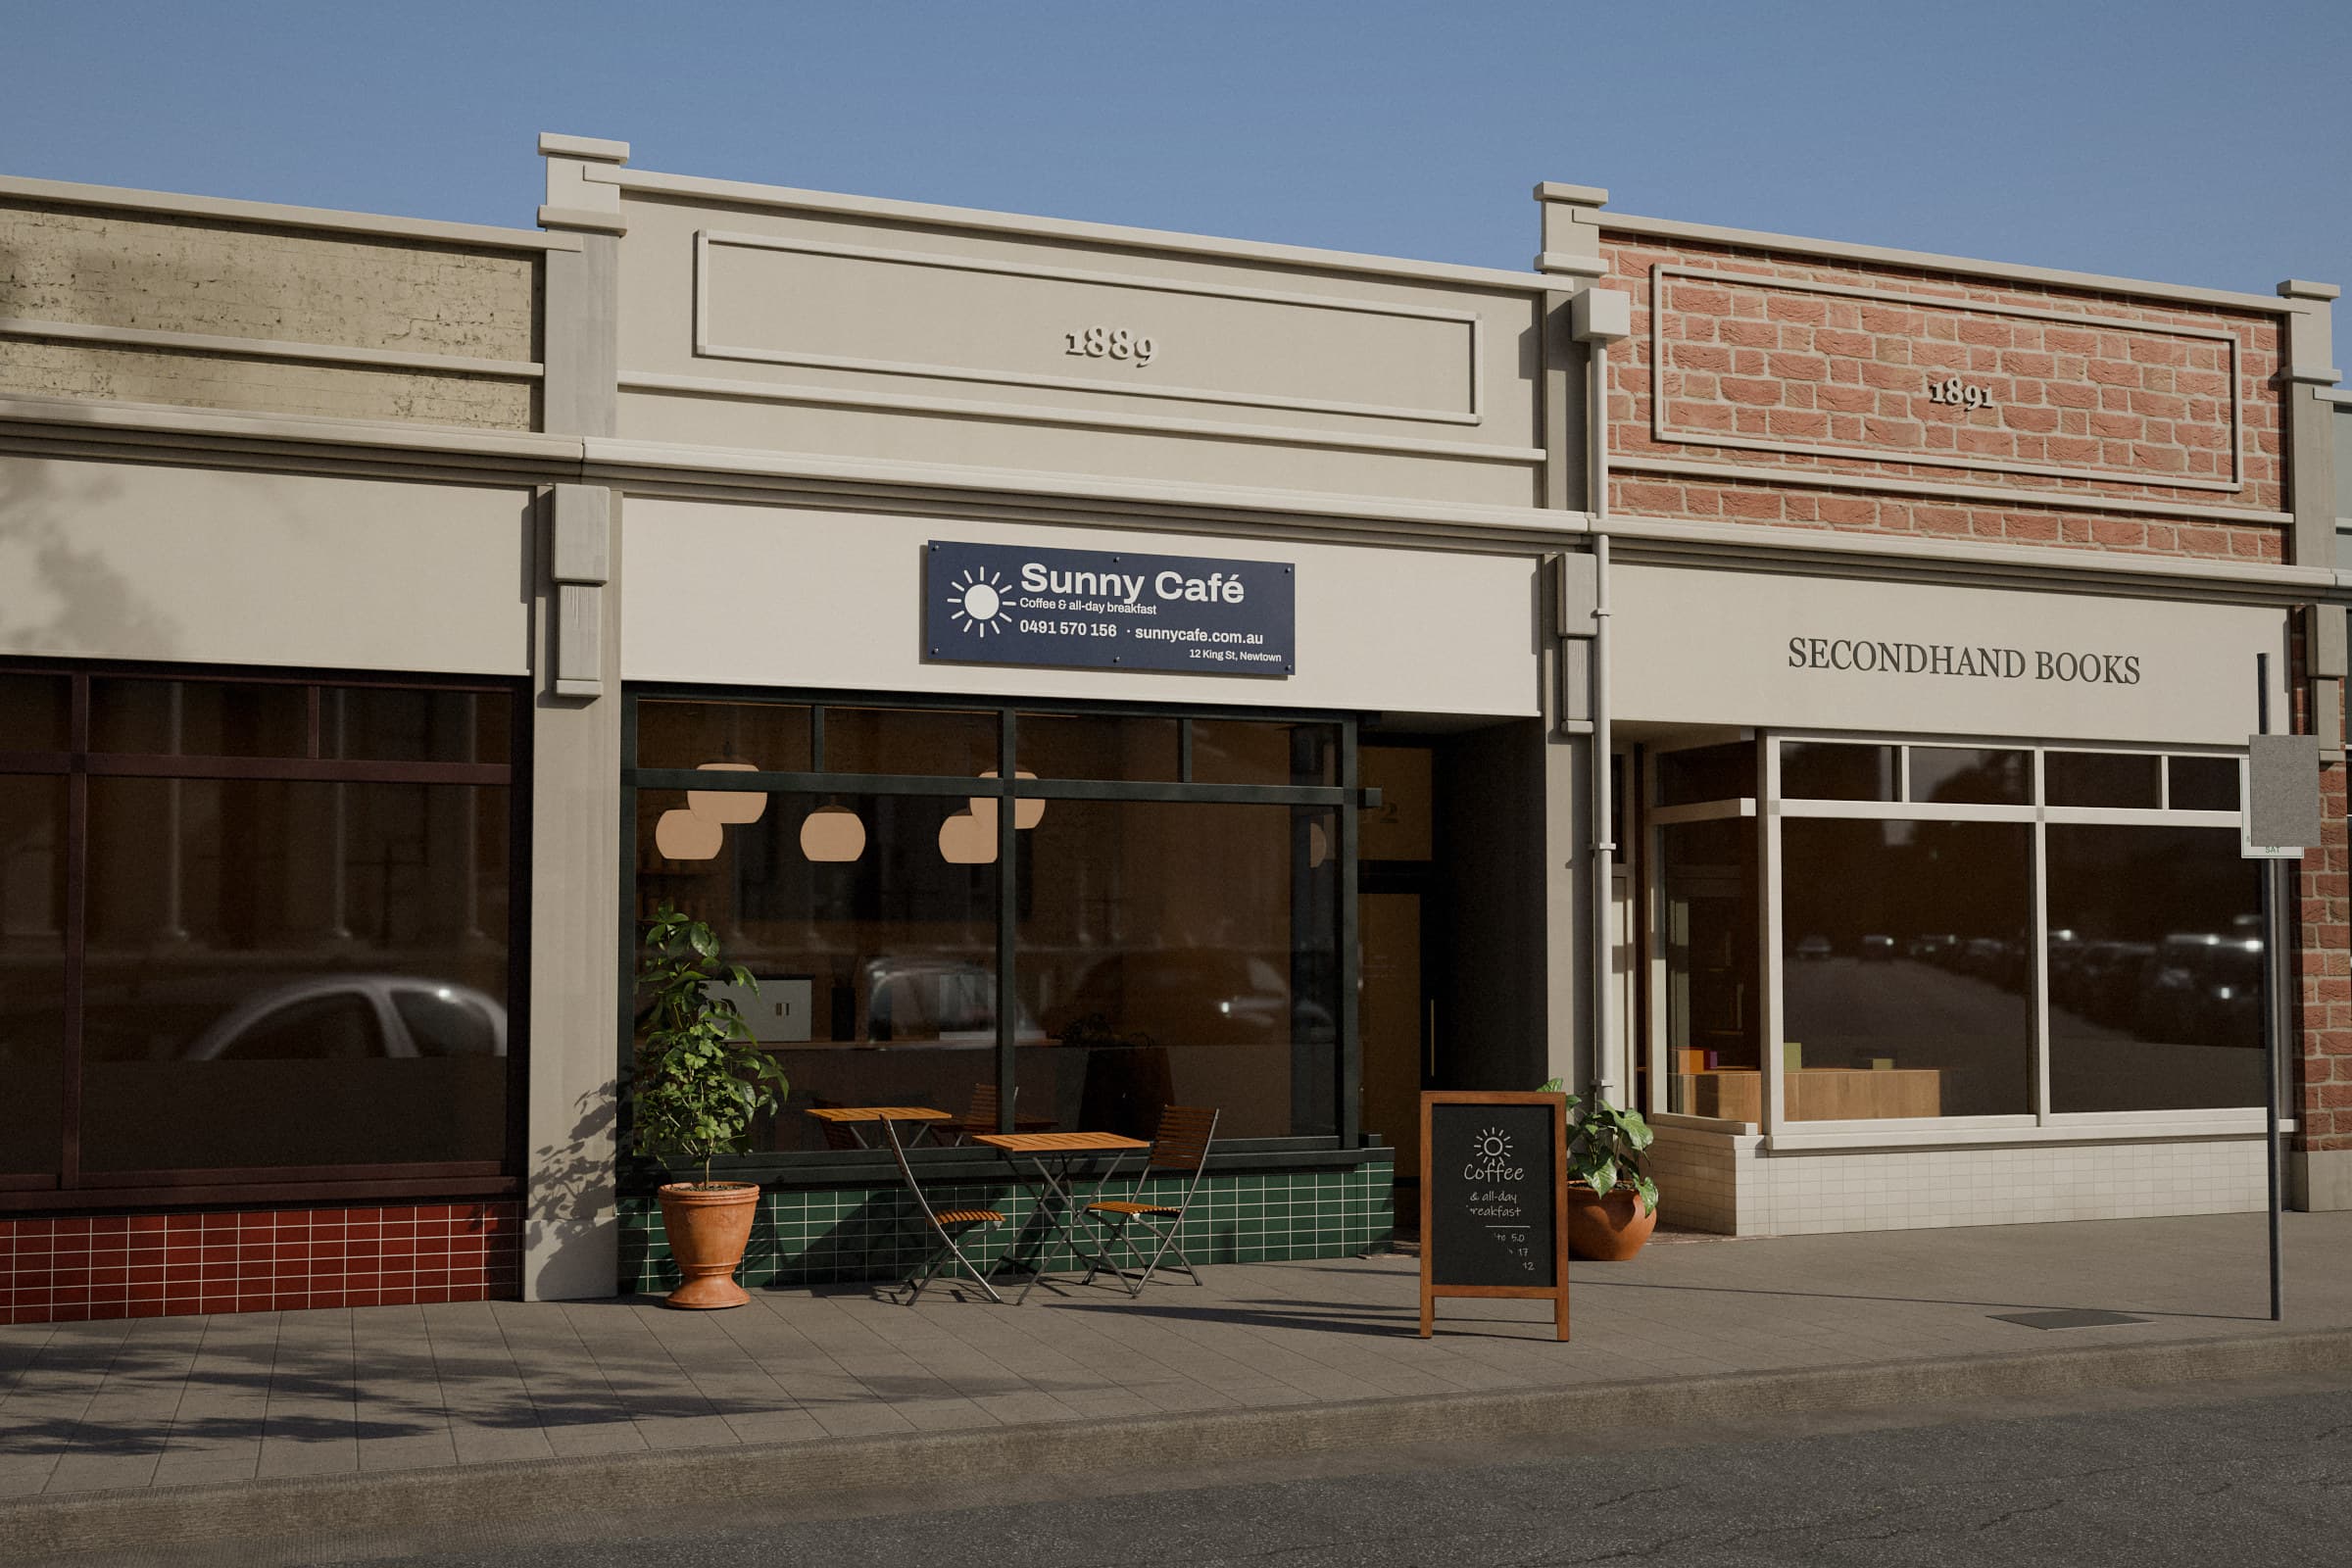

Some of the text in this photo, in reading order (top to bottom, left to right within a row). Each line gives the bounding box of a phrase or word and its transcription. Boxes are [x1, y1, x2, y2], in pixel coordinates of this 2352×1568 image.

[1065, 326, 1157, 368] 1889
[1929, 376, 1994, 413] 1891
[1021, 564, 1244, 604] Sunny Café
[1020, 598, 1156, 614] Coffee & all-day breakfast
[1020, 620, 1056, 634] 0491
[1060, 622, 1086, 635] 570
[1091, 624, 1116, 637] 156
[1136, 628, 1262, 644] sunnycafe.com.au
[1203, 650, 1223, 661] King
[1225, 651, 1238, 661] St,
[1240, 652, 1281, 662] Newtown
[1789, 637, 2139, 684] SECONDHAND BOOKS
[1464, 1162, 1524, 1182] Coffee
[1470, 1191, 1516, 1203] & all-day
[1466, 1204, 1521, 1217] reakfast
